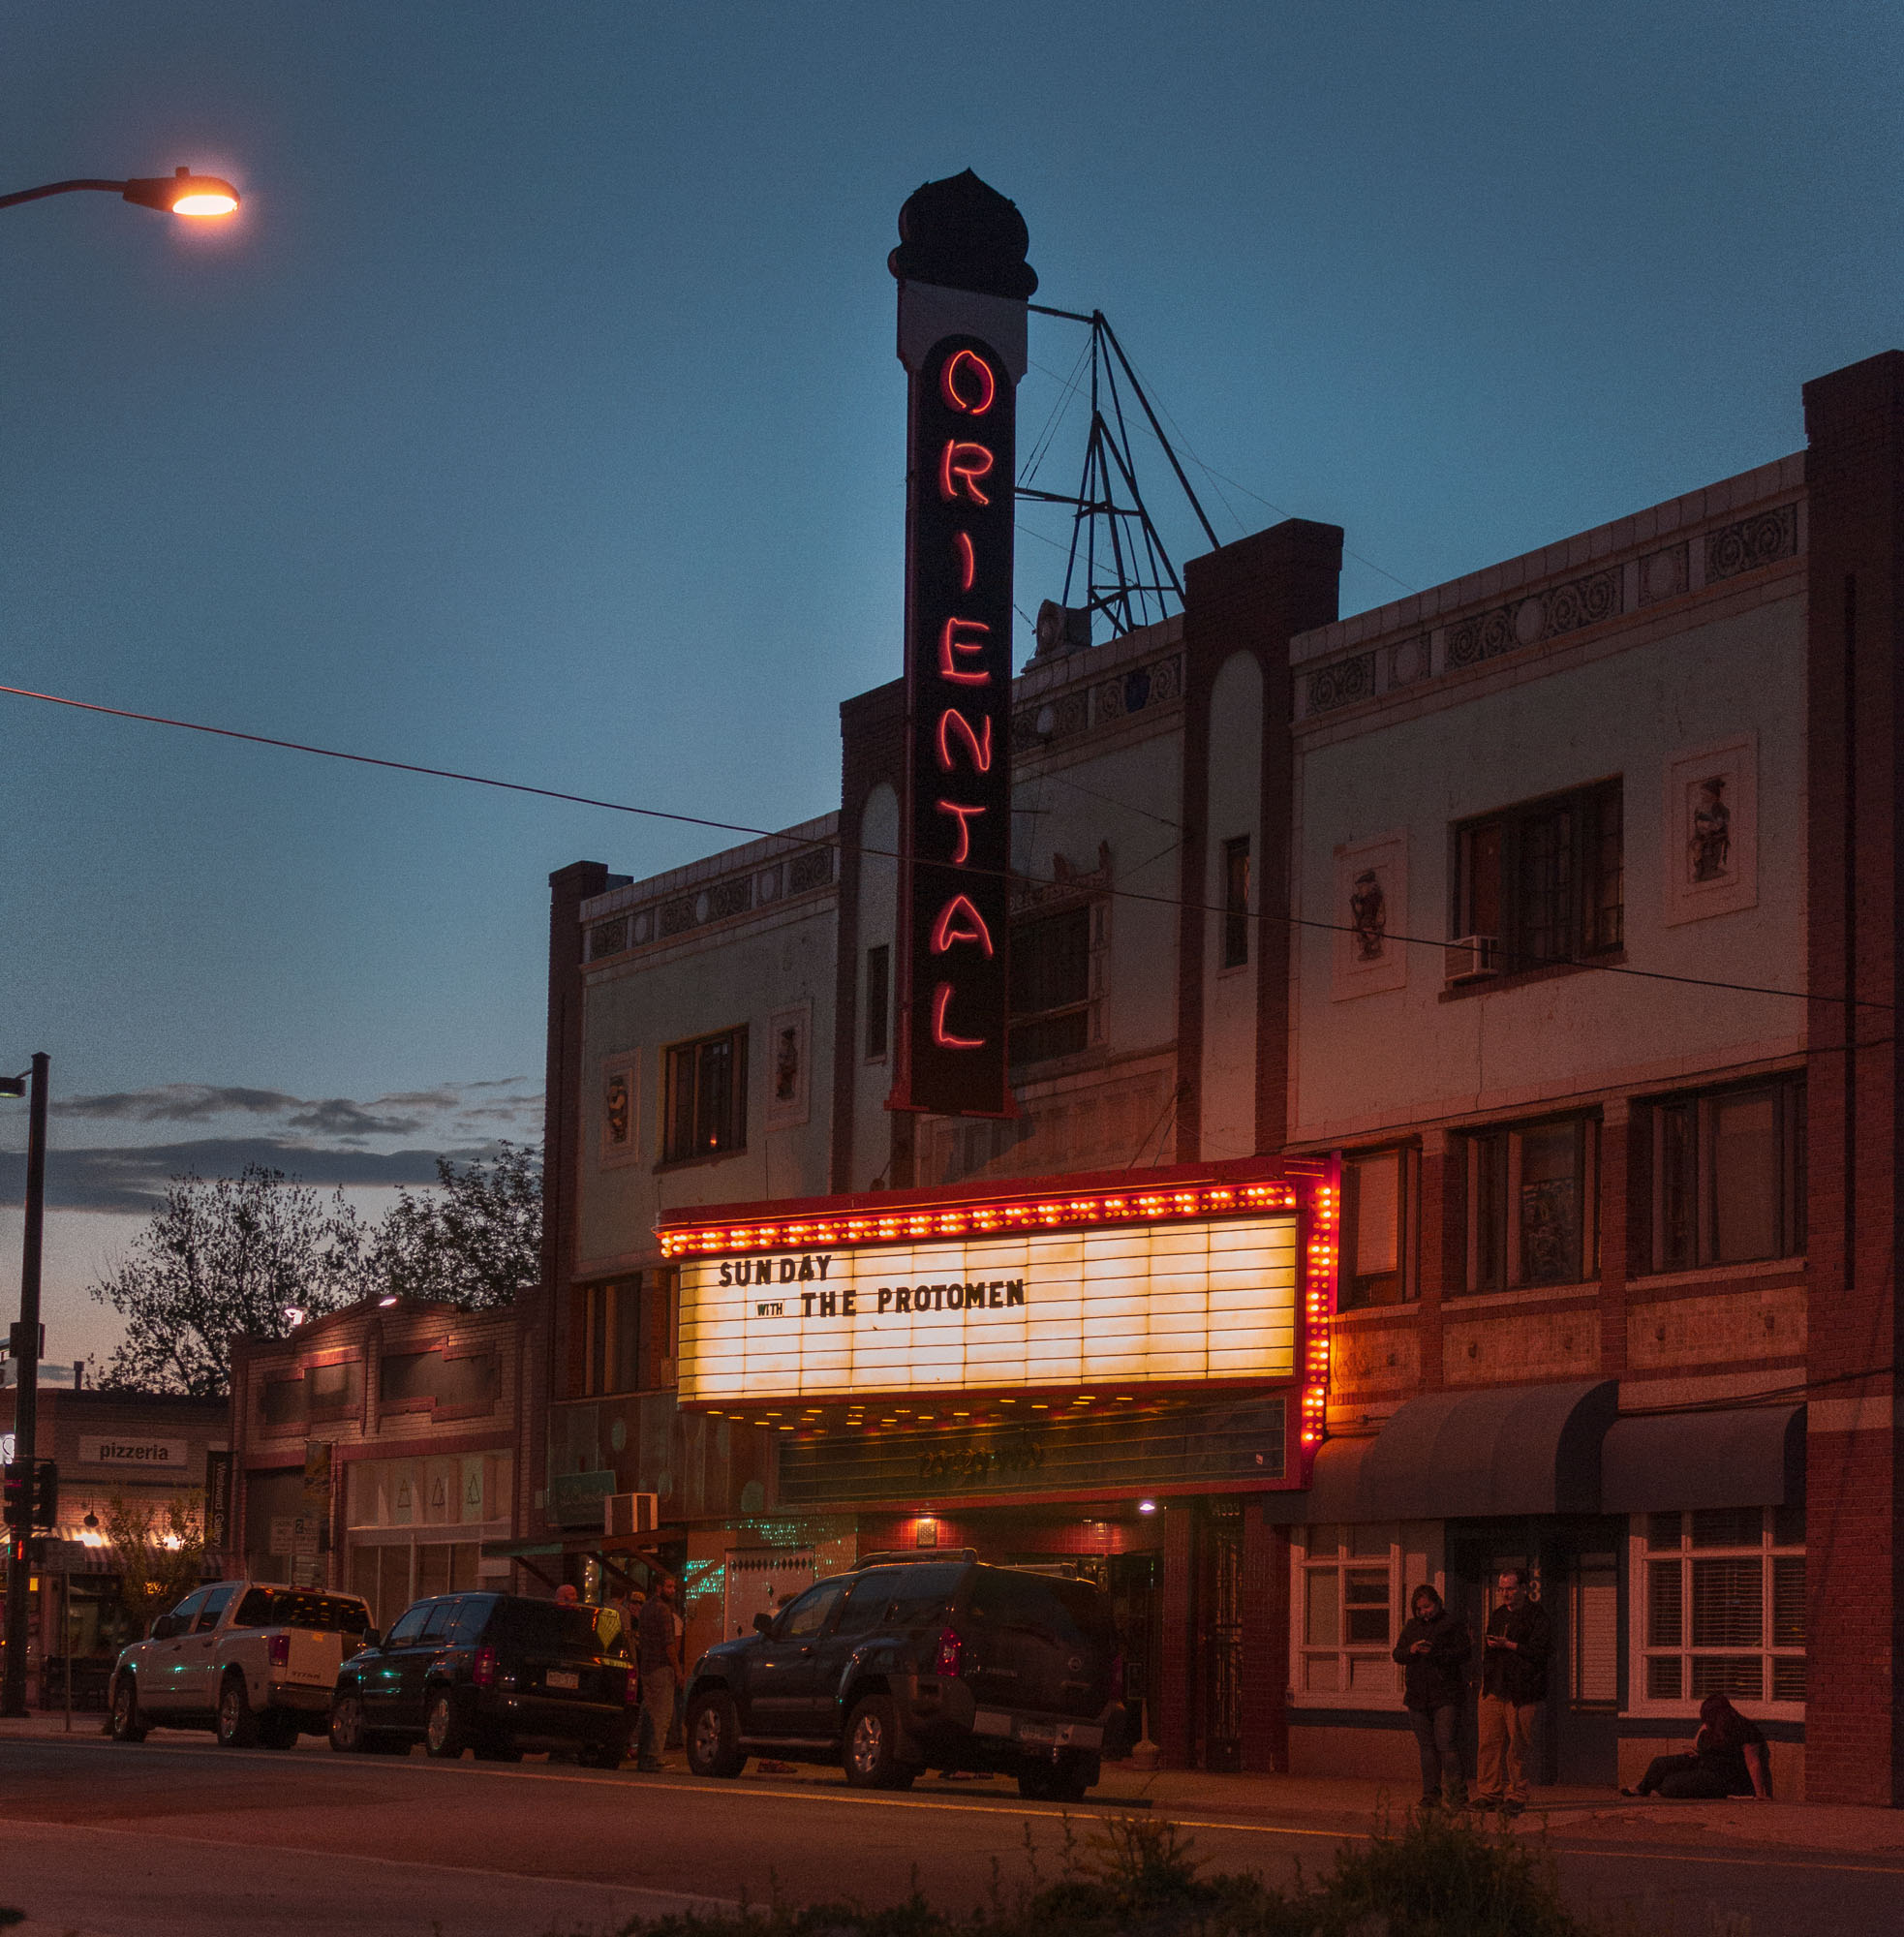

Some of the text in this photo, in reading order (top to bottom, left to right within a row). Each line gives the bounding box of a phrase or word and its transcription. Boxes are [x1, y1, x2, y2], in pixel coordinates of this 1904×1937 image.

[933, 349, 997, 1049] ORIENTAL
[718, 1254, 832, 1288] SUNDAY
[756, 1278, 1025, 1318] WITH THE PROTOMEN
[100, 1442, 169, 1460] pizzeria
[213, 1513, 226, 1548] Gallery
